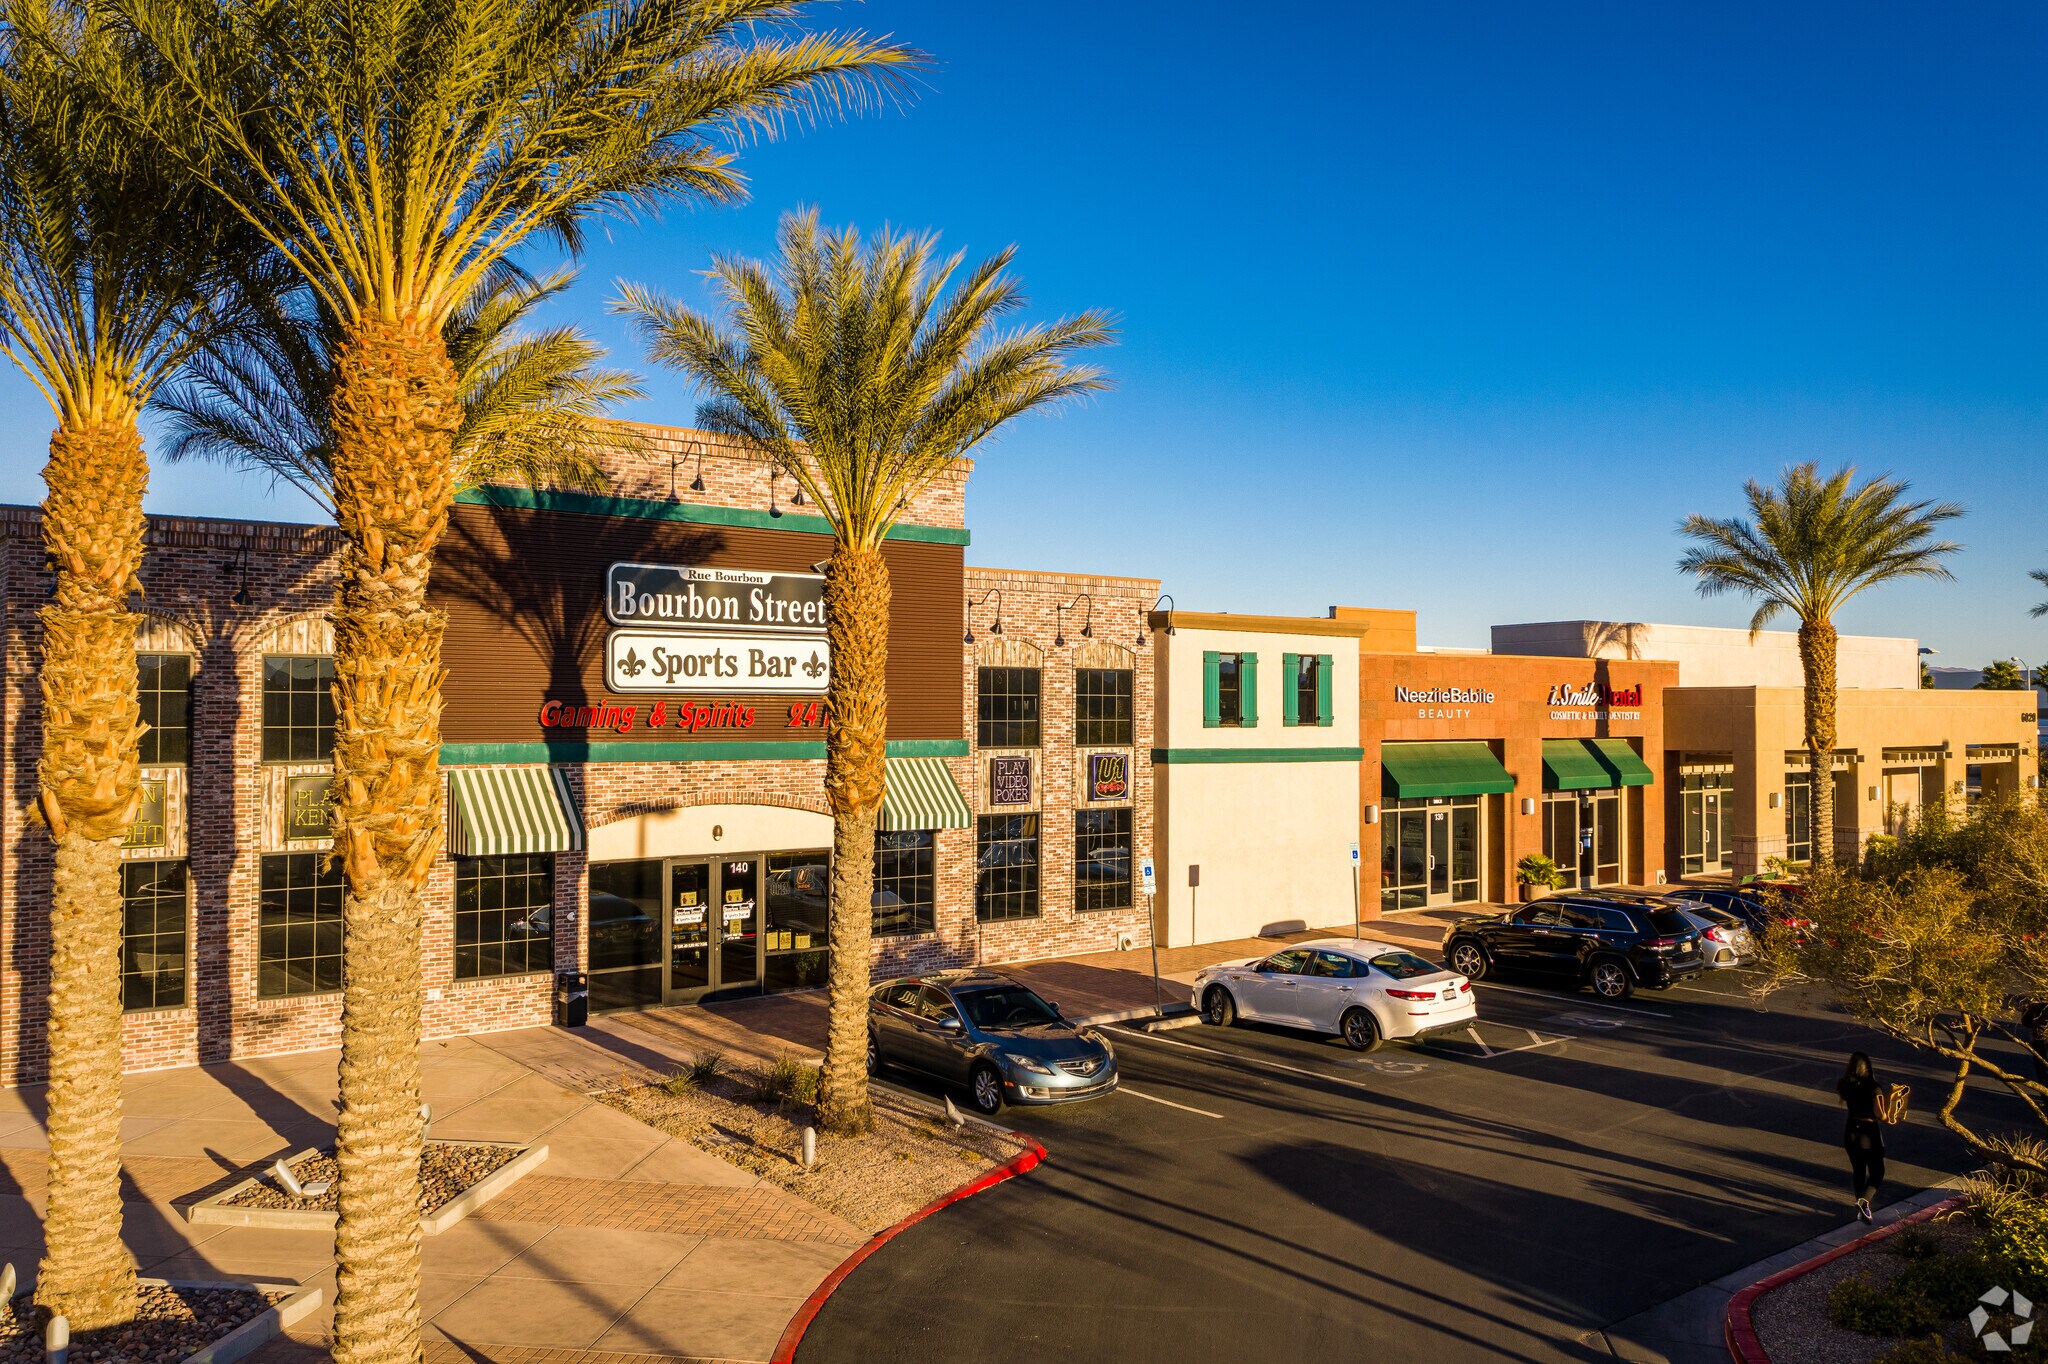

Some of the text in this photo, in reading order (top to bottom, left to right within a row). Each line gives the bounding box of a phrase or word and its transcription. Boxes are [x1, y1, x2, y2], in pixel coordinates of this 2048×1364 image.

[688, 570, 763, 583] Rue Bourbon
[617, 581, 827, 624] Bourbon Street
[651, 647, 797, 684] Sports Bar
[1396, 685, 1495, 703] NeeziieBabiie
[541, 700, 638, 732] Gaming
[650, 701, 667, 727] &
[678, 701, 756, 732] Spirits
[788, 702, 817, 727] 24
[1418, 709, 1470, 719] BEAUTY
[1550, 711, 1581, 720] COSMETIC
[1609, 711, 1640, 720] DENTISTRY
[998, 761, 1025, 775] PLAY
[998, 775, 1028, 788] VIDEO
[296, 789, 334, 807] PLA
[996, 788, 1028, 801] POKER
[730, 862, 748, 874] 140
